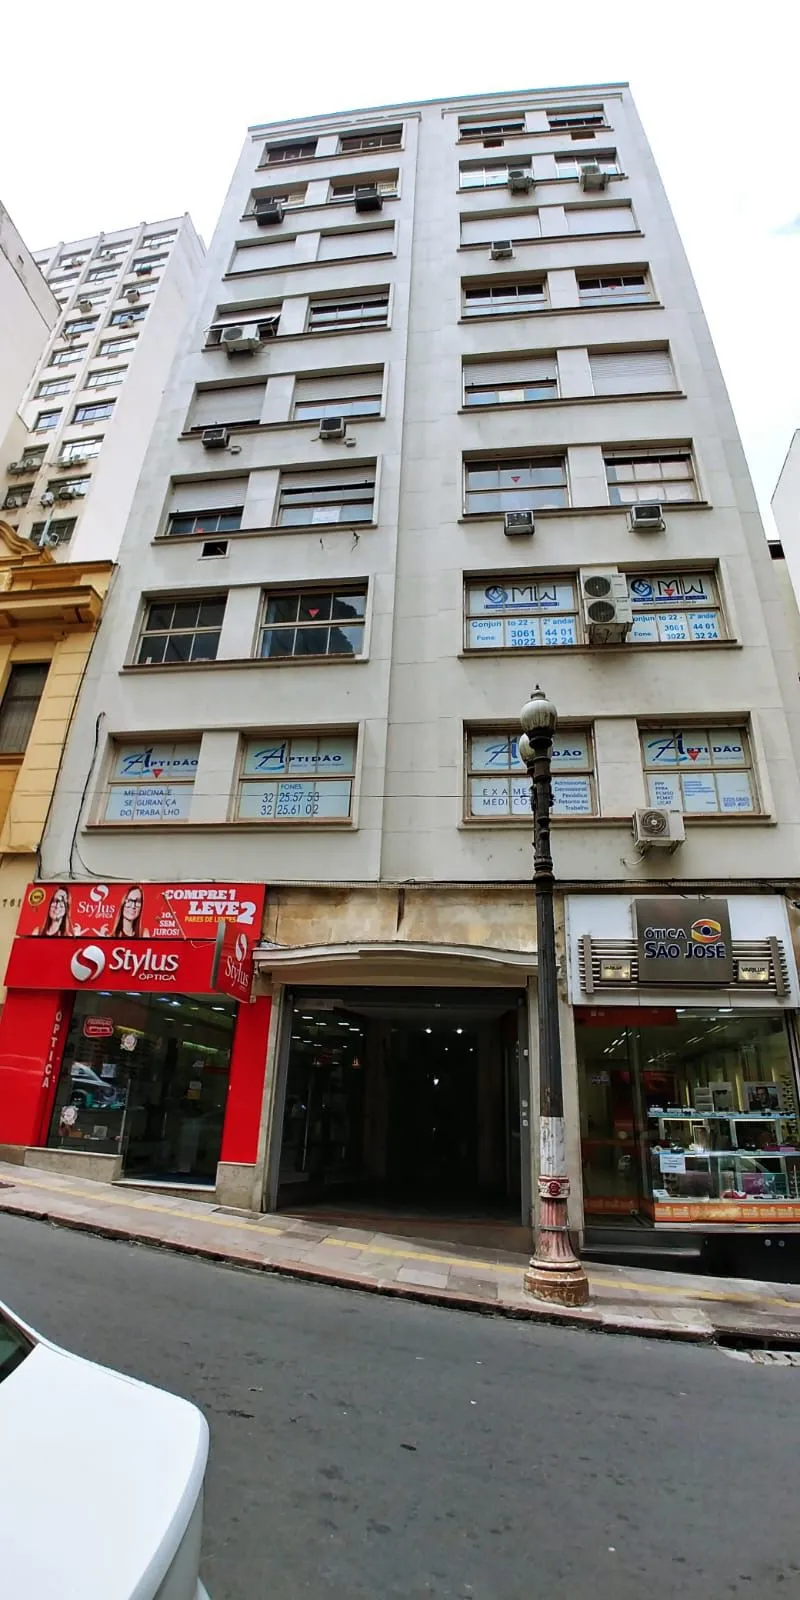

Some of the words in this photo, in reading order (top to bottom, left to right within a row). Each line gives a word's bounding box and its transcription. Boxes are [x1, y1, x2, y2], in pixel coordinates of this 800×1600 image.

[511, 629, 535, 638] 3061
[511, 638, 536, 646] 3022
[482, 788, 528, 796] EXAME
[482, 797, 529, 806] MÉDICO
[164, 889, 228, 900] COMPRE
[228, 889, 236, 900] 1
[77, 900, 116, 918] Stylus
[188, 901, 240, 915] LEVE
[237, 901, 257, 925] 2
[159, 919, 176, 928] SEM
[152, 928, 180, 937] JUROS!
[644, 926, 688, 940] ÓTICA
[644, 942, 680, 959] SÃO
[684, 942, 726, 959] JOSÉ
[109, 947, 180, 977] Stylus
[225, 955, 249, 987] Stylus
